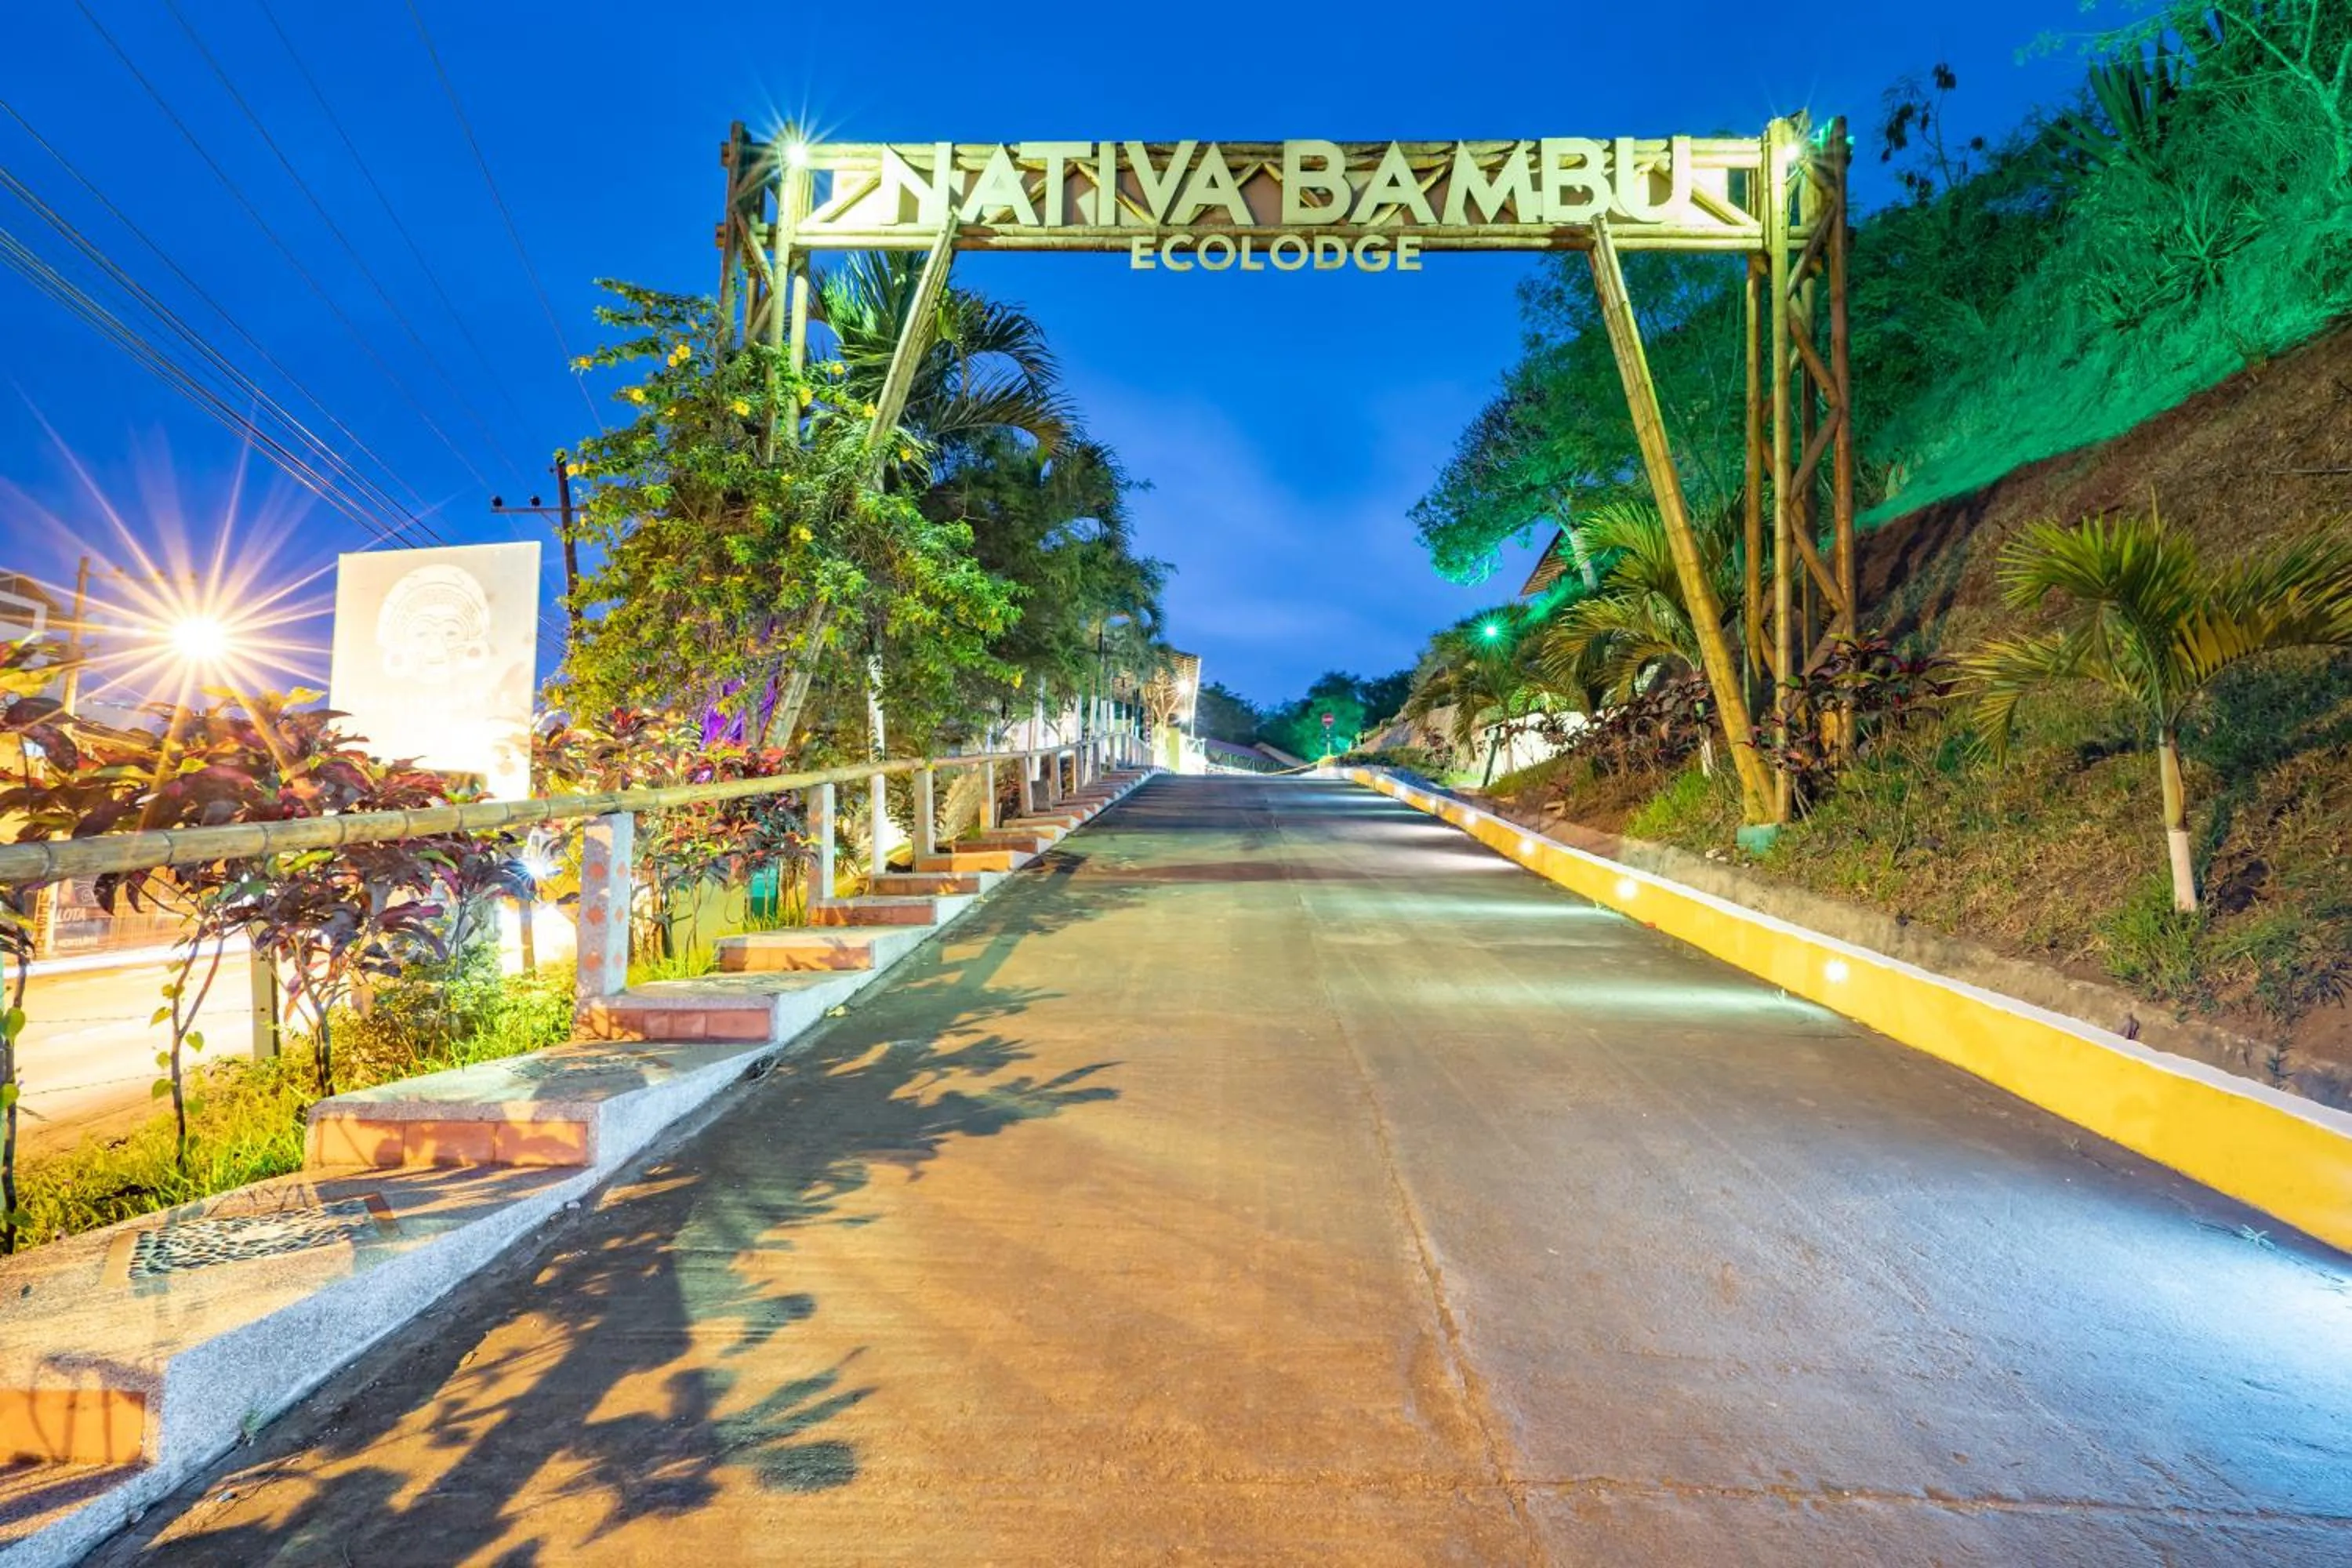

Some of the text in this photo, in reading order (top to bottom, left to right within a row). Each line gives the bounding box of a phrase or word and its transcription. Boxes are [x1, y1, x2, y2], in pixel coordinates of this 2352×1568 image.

[880, 136, 1693, 227] NATIVA BAMBU
[1130, 234, 1423, 271] ECOLODGE
